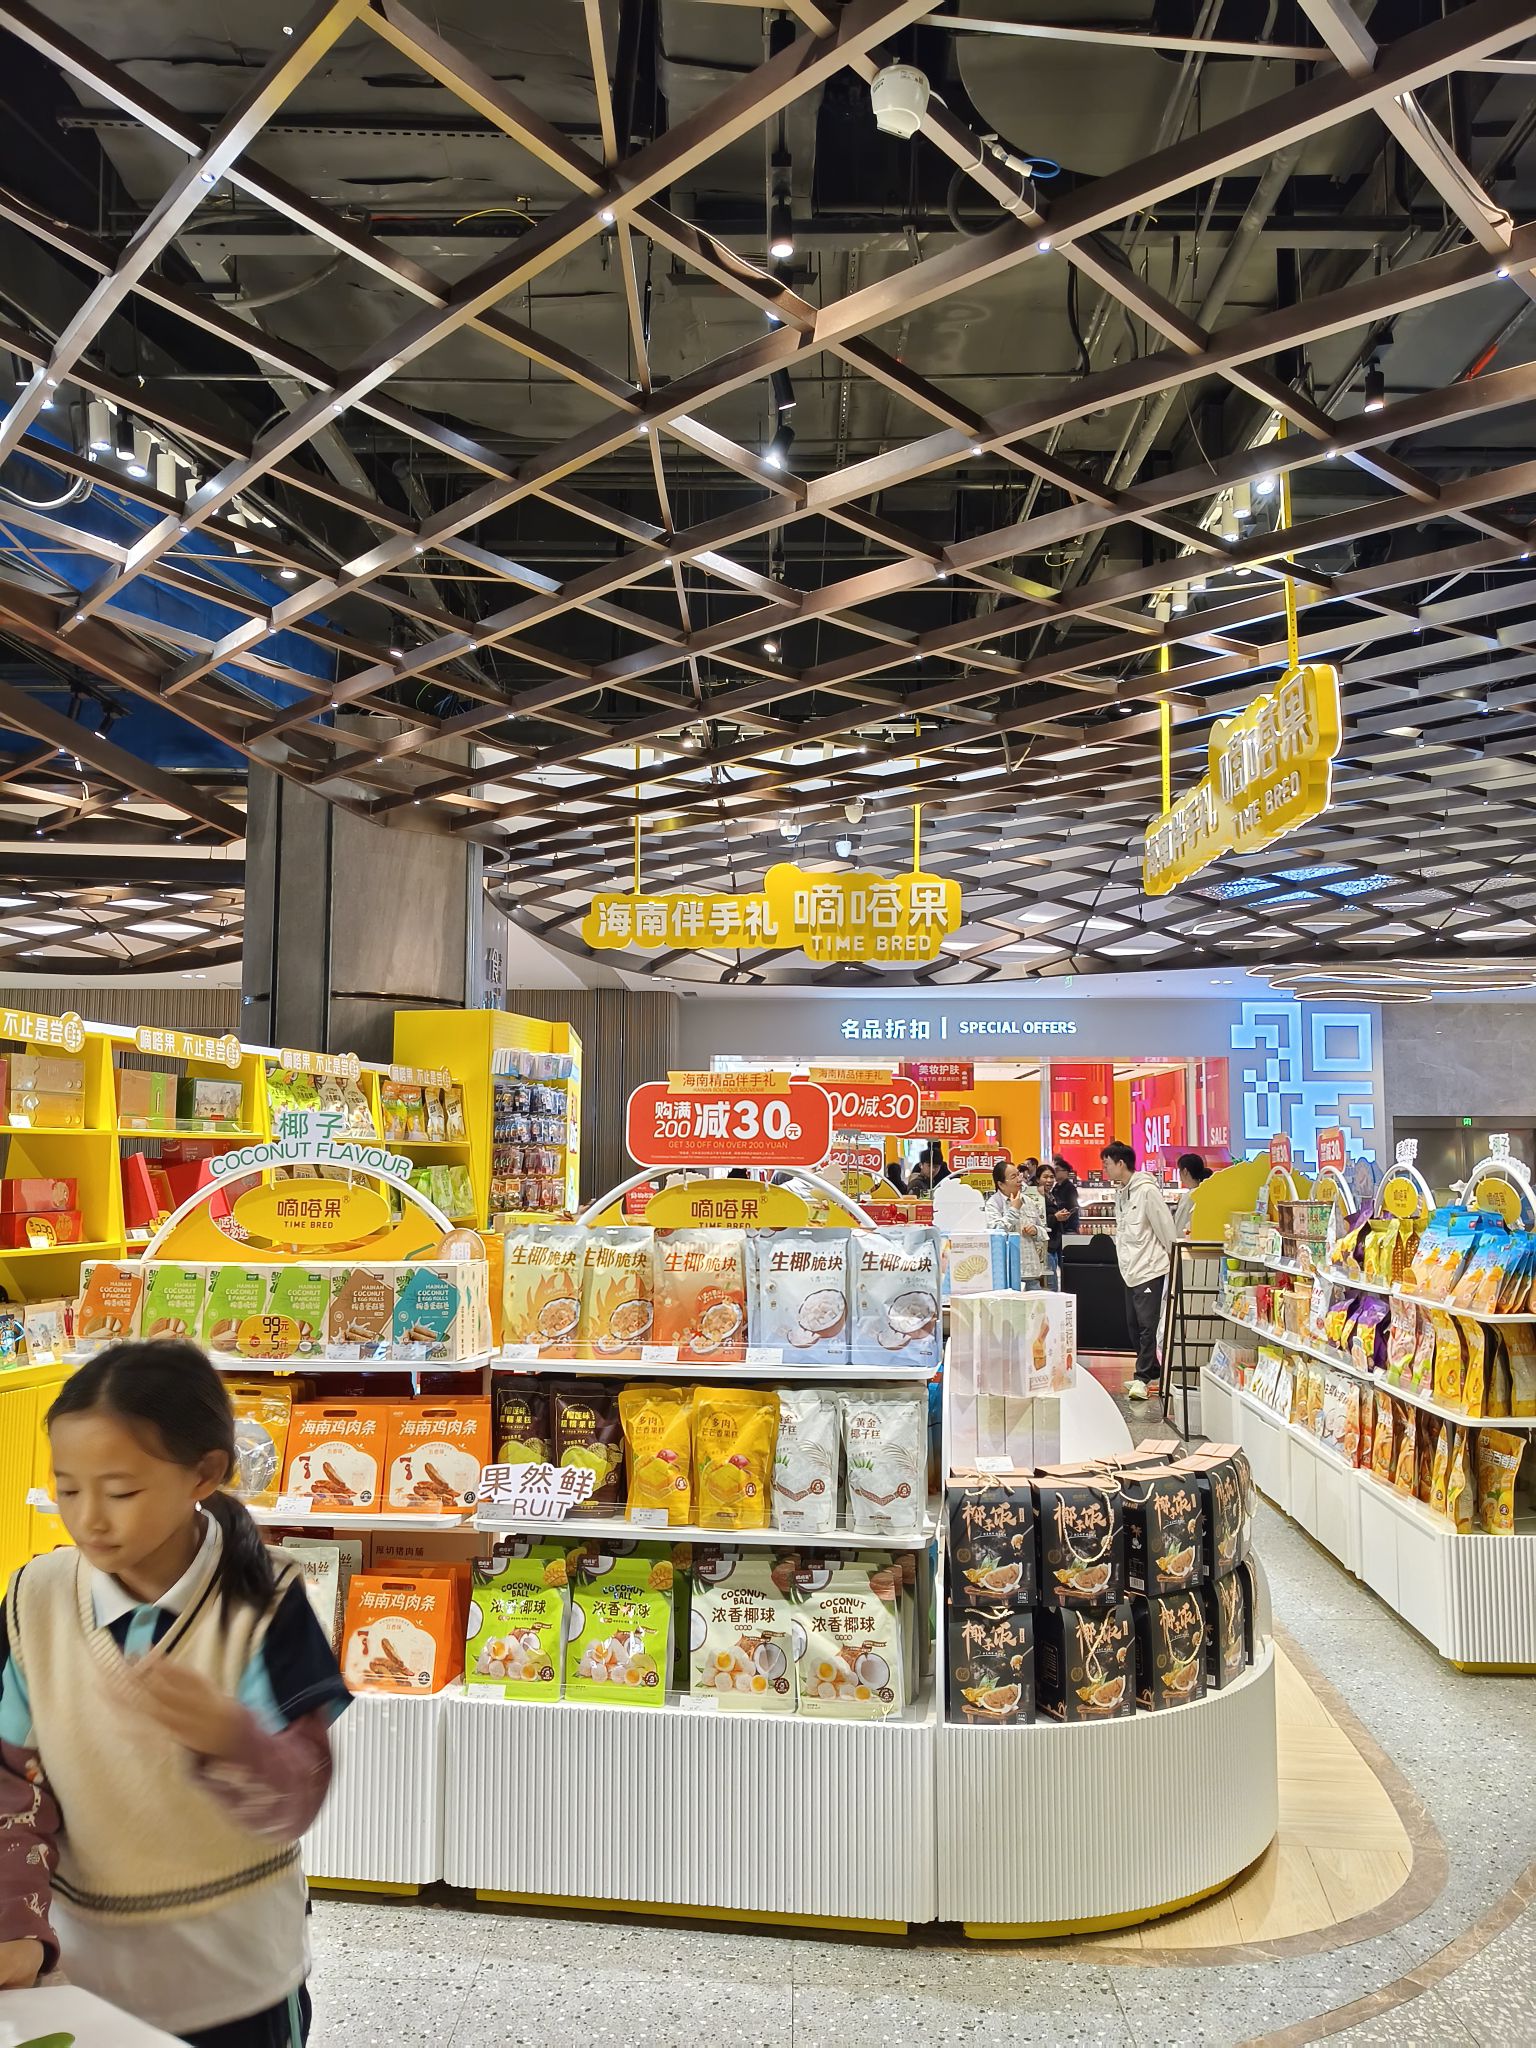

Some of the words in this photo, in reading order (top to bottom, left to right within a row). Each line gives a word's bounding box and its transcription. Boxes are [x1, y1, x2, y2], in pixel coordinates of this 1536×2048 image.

[1231, 799, 1261, 839] TIME
[1264, 770, 1302, 816] BRED
[793, 882, 949, 929] 嘀嗒果
[598, 900, 779, 937] 海南伴手礼
[811, 934, 866, 951] TIME
[876, 934, 931, 951] BRED
[840, 1018, 931, 1040] 名品折扣
[959, 1020, 1021, 1034] SPECIAL
[1023, 1020, 1077, 1034] OFFERS
[918, 1064, 960, 1074] 美妆护肤
[682, 1073, 776, 1087] 海南精品伴手礼
[654, 1101, 691, 1120] 购满
[279, 1112, 343, 1140] 椰子
[653, 1120, 691, 1138] 200
[1058, 1122, 1105, 1138] SALE
[1144, 1115, 1171, 1154] SALE
[1210, 1127, 1228, 1144] SALE
[668, 1141, 685, 1149] GET
[685, 1141, 695, 1149] 30
[696, 1141, 711, 1149] OFF
[713, 1141, 725, 1149] ON
[726, 1141, 746, 1149] OVER
[748, 1141, 764, 1149] 200
[765, 1141, 788, 1149] YUAN
[211, 1142, 312, 1175] COCONUT
[316, 1143, 410, 1178] FLAVOUR
[277, 1198, 341, 1218] 嘀嗒果
[691, 1199, 759, 1219] 嘀嗒果
[284, 1221, 306, 1229] TIME
[310, 1221, 333, 1229] BRED
[511, 1244, 577, 1267] 生椰脆块
[664, 1252, 737, 1272] 生椰脆块
[769, 1251, 843, 1272] 生椰脆块
[860, 1251, 933, 1272] 生椰脆块
[299, 1419, 377, 1436] 海南鸡肉条
[399, 1419, 478, 1437] 海南鸡肉条
[856, 1417, 877, 1429] 黄金
[480, 1465, 594, 1500] 果然鲜
[501, 1582, 542, 1594] COCONUT
[511, 1590, 530, 1598] BALL
[602, 1584, 645, 1597] COCONUT
[614, 1592, 632, 1600] BALL
[721, 1588, 767, 1601] COCONUT
[358, 1591, 437, 1612] 海南鸡肉条
[733, 1597, 754, 1605] BALL
[820, 1597, 867, 1610] COCONUT
[711, 1606, 776, 1623] 浓香椰球
[832, 1606, 853, 1614] BALL
[811, 1616, 876, 1633] 浓香椰球
